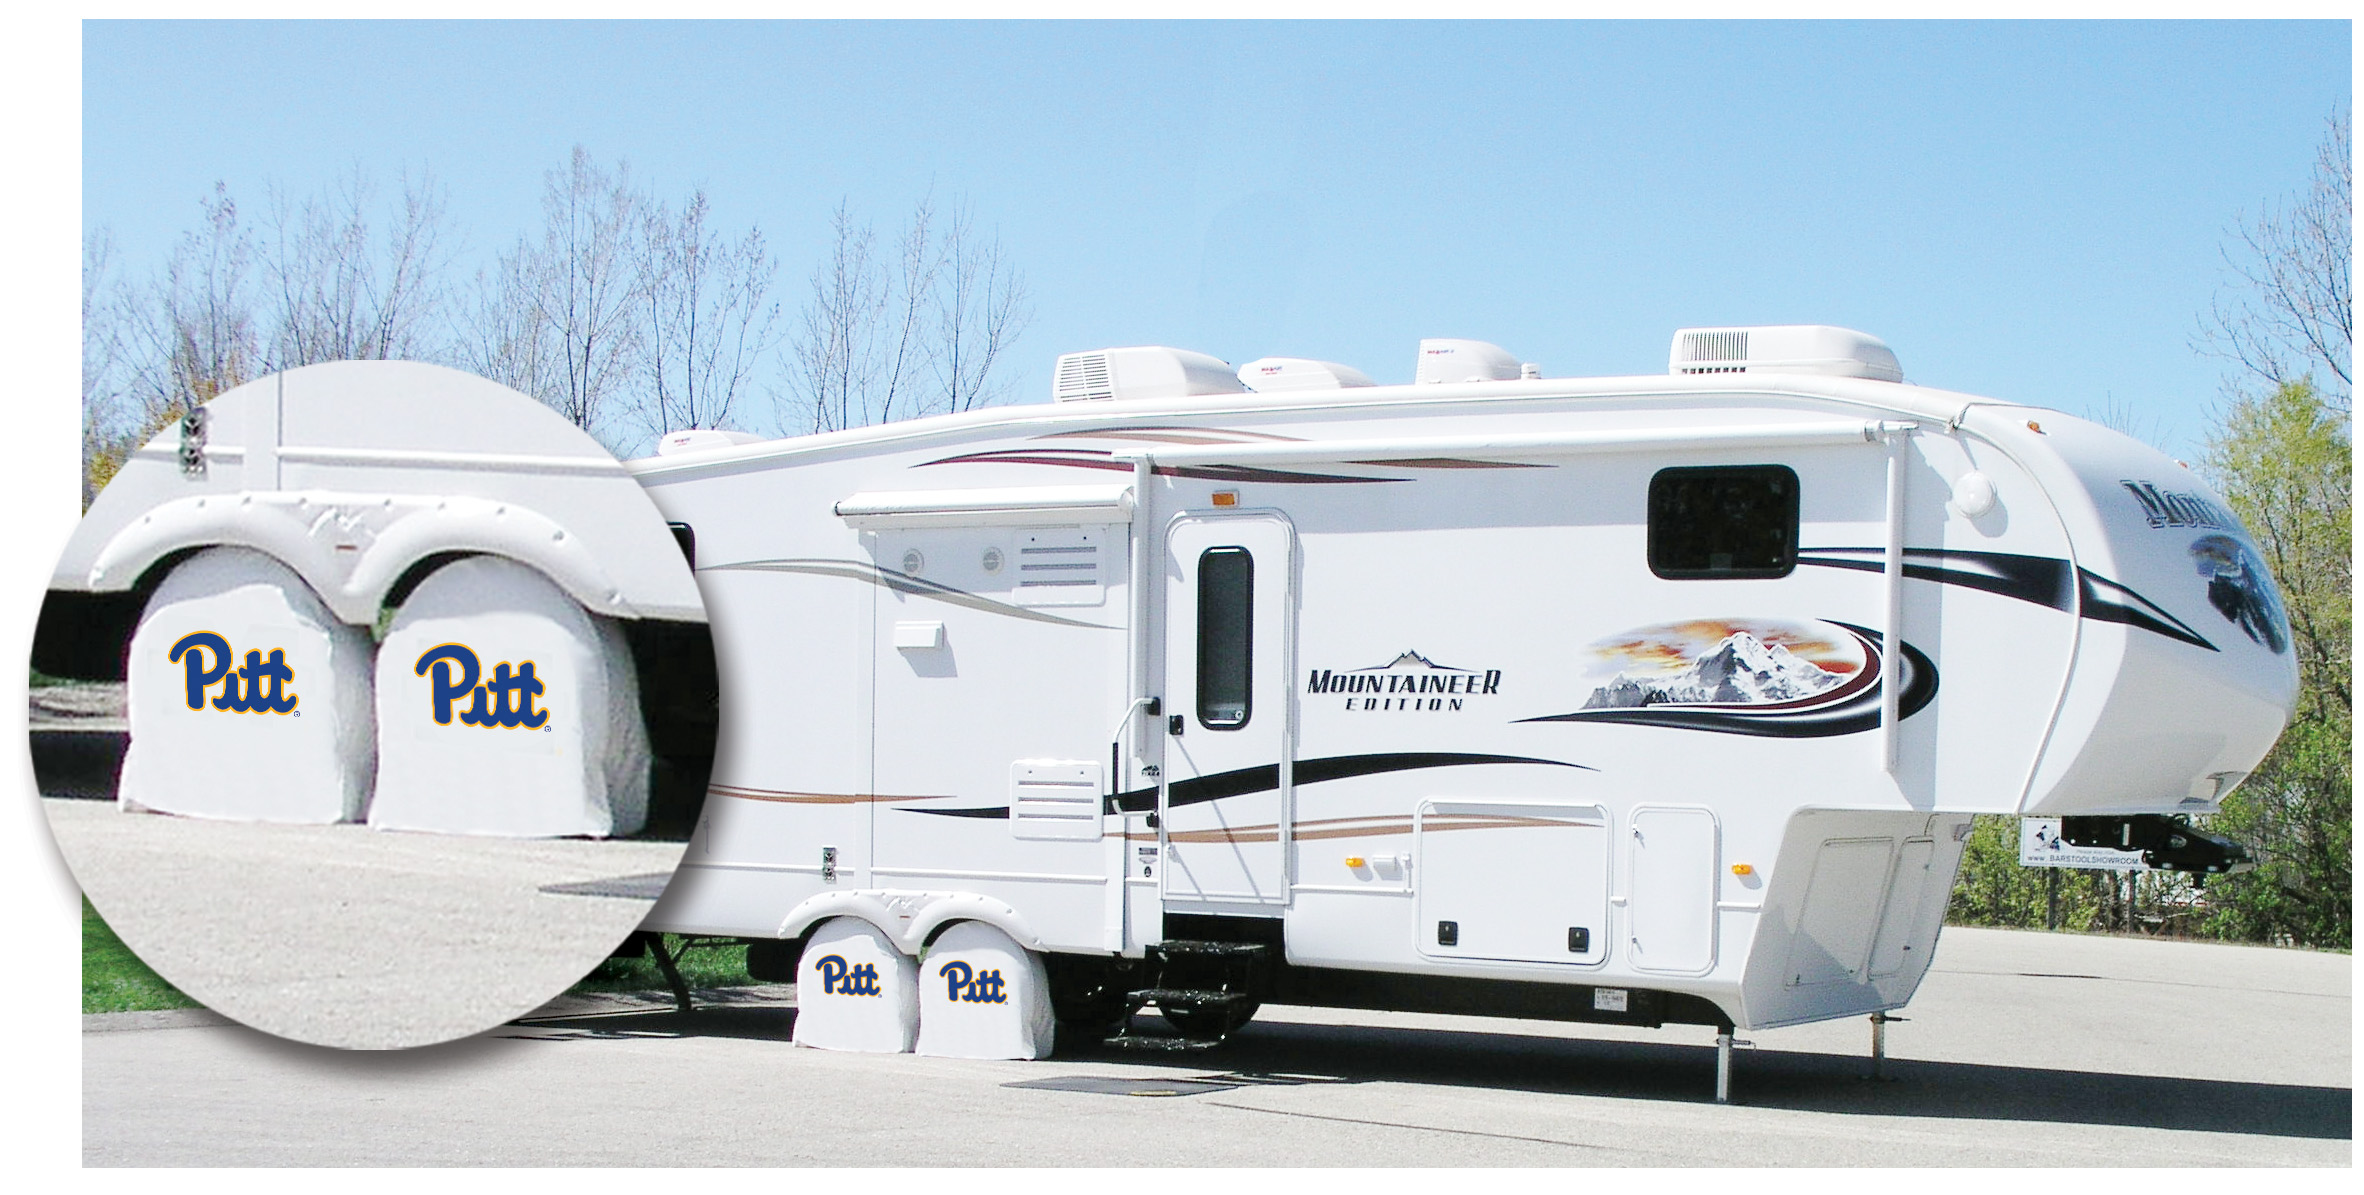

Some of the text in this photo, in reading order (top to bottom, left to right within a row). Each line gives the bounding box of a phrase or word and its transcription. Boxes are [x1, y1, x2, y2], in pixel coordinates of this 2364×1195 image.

[168, 630, 299, 715] Pitt
[414, 642, 550, 730] Pitt
[1308, 669, 1501, 694] MOUNTAINEER
[1346, 698, 1463, 711] EDITION
[815, 954, 882, 996] Pitt
[939, 960, 1008, 1003] Pitt
